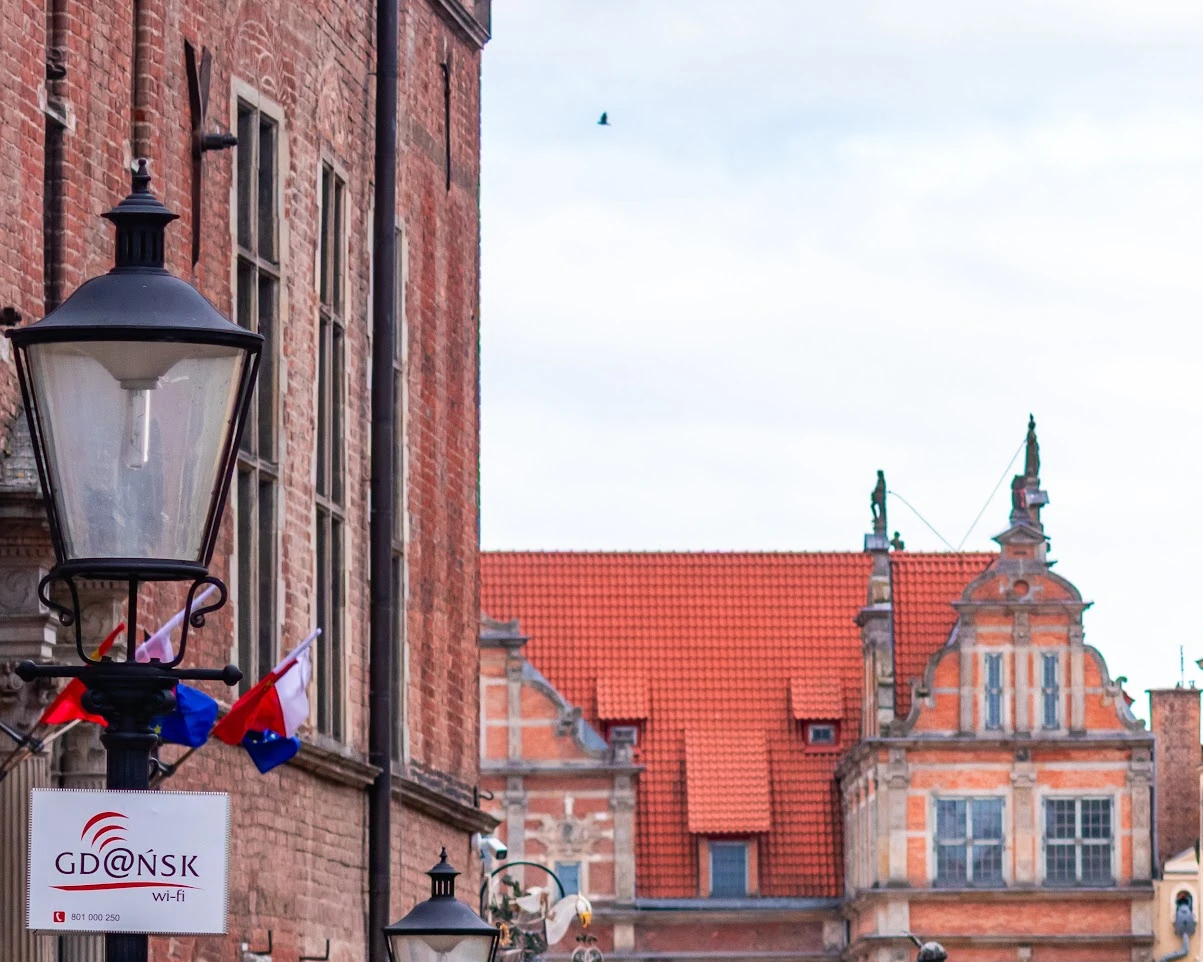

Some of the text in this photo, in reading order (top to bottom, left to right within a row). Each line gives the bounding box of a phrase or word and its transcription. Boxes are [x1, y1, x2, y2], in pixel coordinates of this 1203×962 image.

[55, 847, 200, 879] GD@ŃSK
[152, 889, 186, 902] wi-fi
[71, 913, 121, 922] 801 000 250
